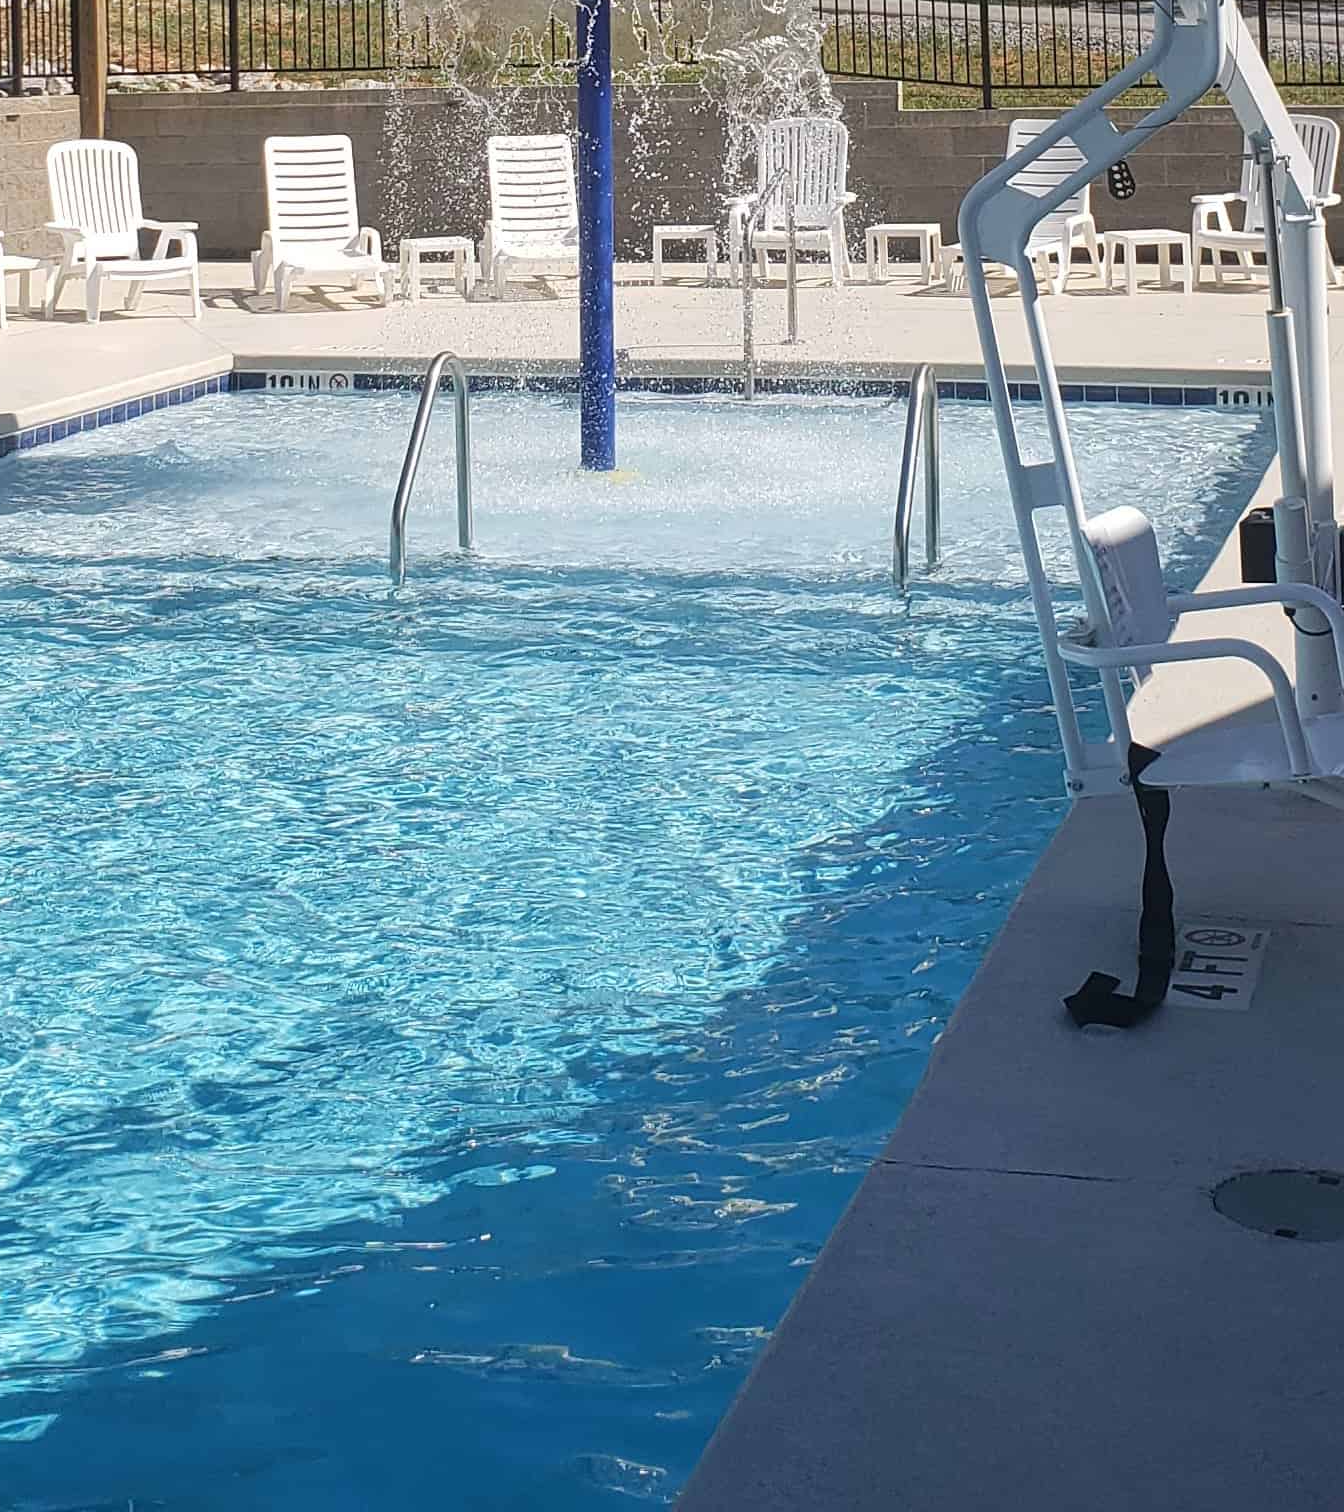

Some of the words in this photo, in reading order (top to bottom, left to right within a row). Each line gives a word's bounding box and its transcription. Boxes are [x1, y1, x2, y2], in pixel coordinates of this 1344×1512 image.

[300, 375, 320, 390] IN
[1178, 950, 1248, 976] FT
[1172, 984, 1238, 1000] 4
